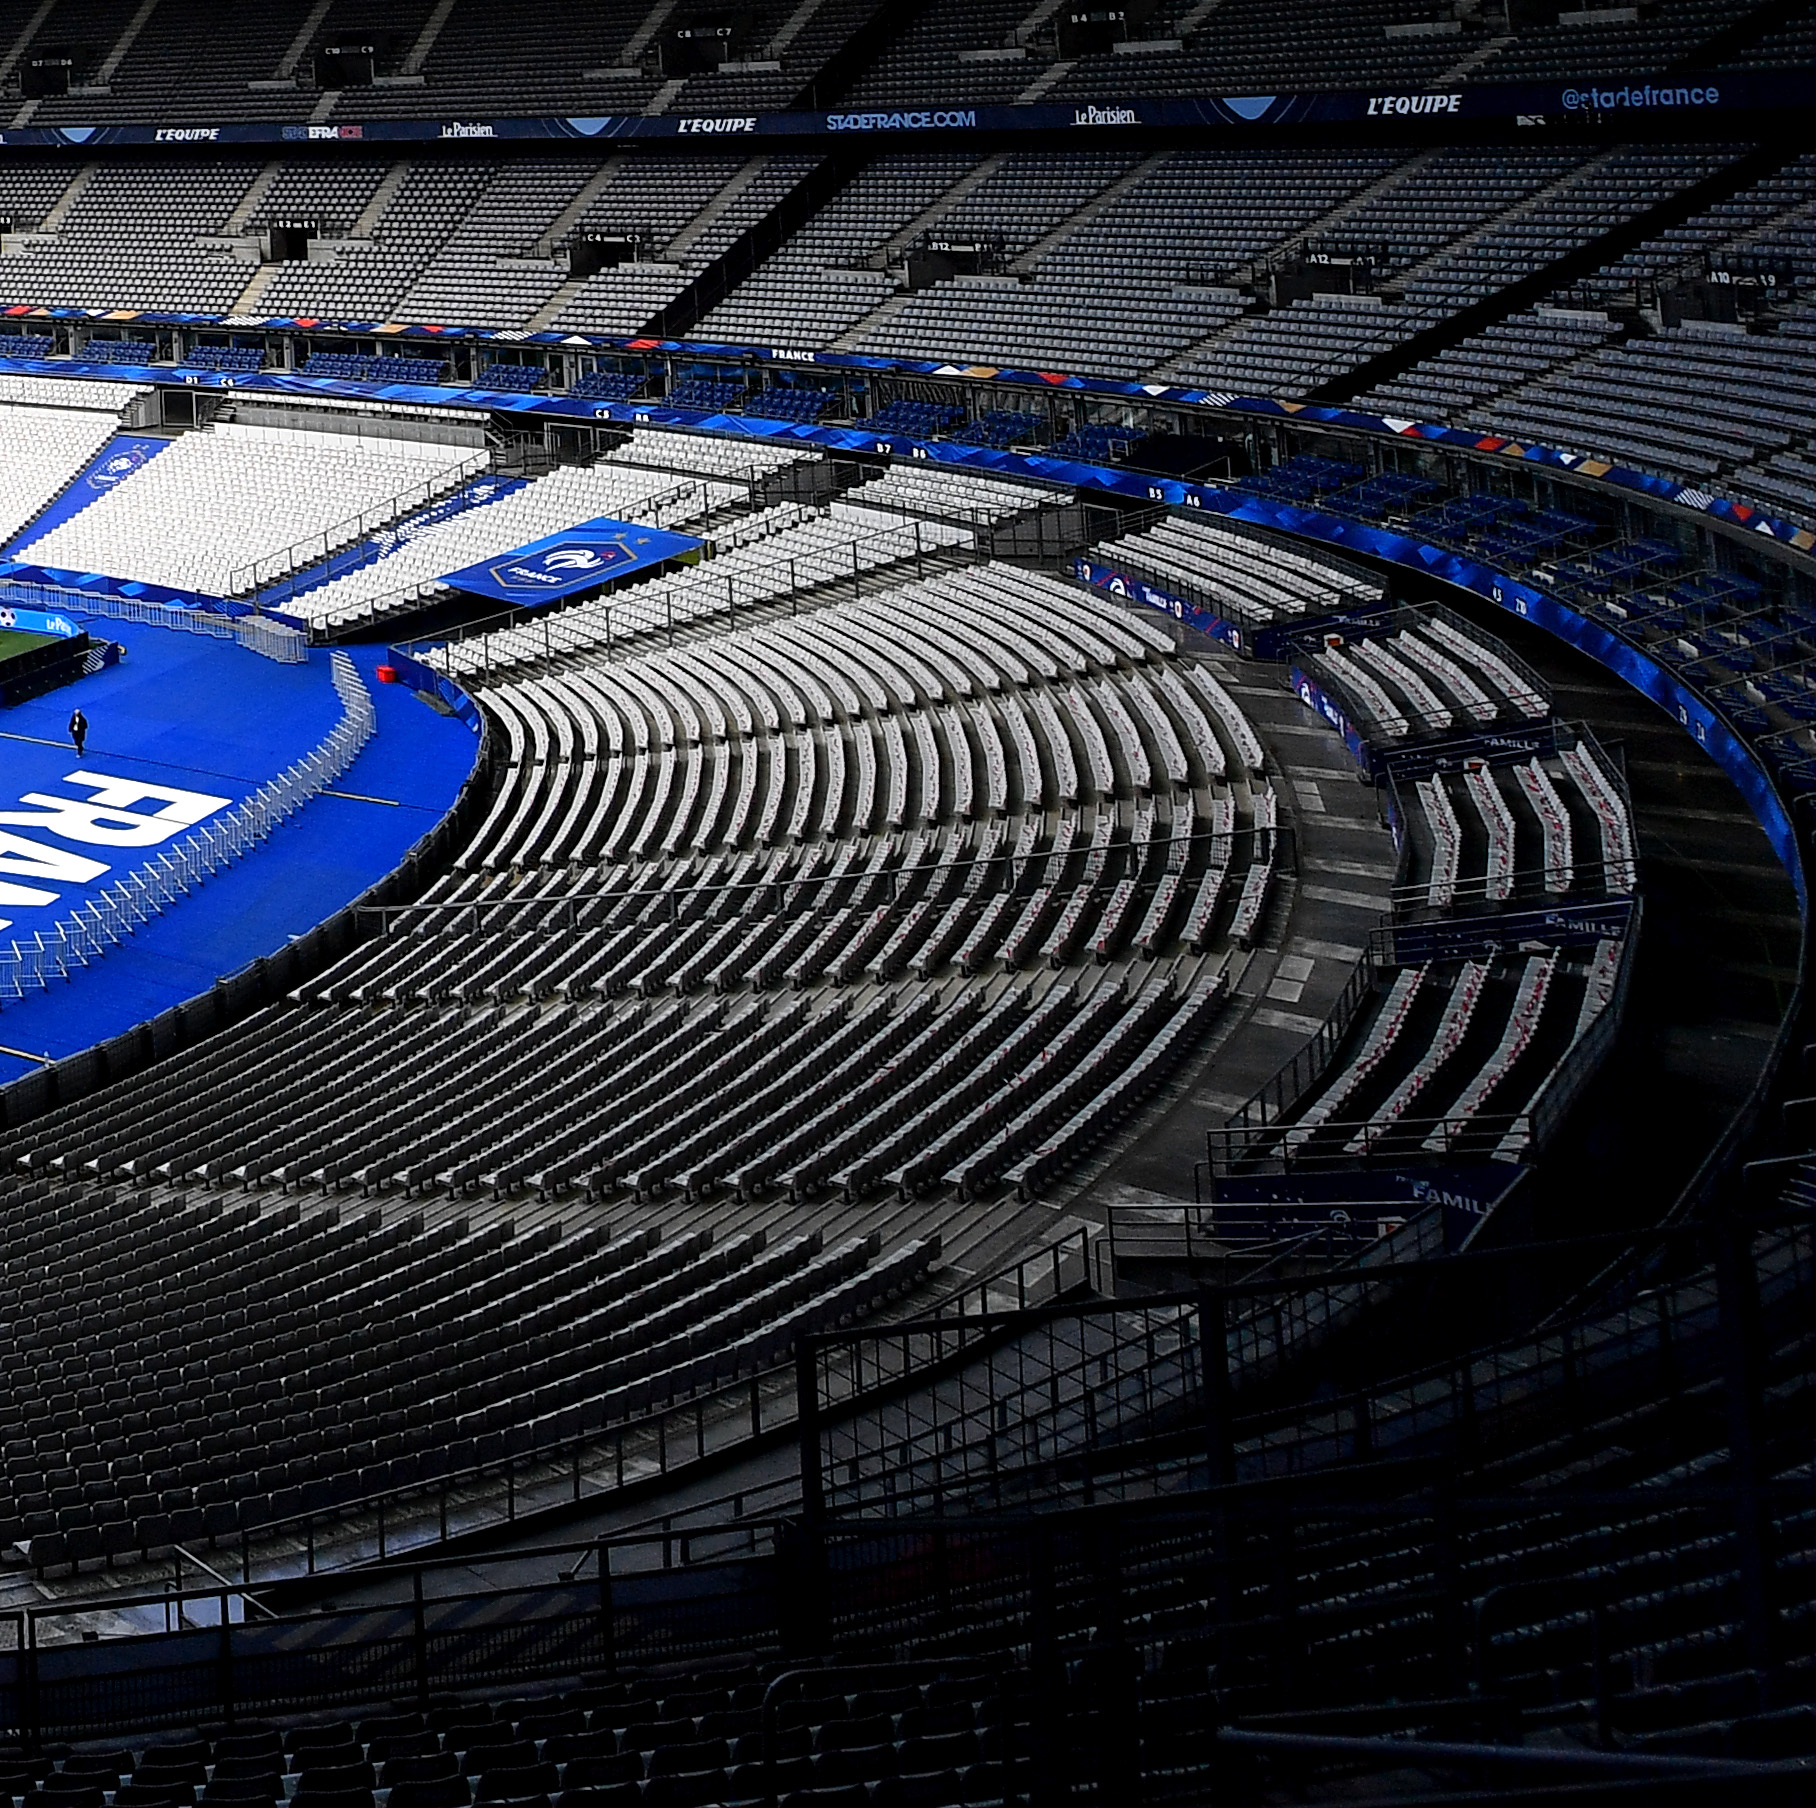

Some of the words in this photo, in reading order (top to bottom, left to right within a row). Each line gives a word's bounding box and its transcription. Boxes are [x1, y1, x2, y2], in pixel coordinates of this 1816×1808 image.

[1071, 13, 1088, 23] B4
[677, 29, 692, 39] C8
[716, 28, 731, 36] C7
[1561, 85, 1719, 110] @stadefrance
[1367, 94, 1463, 116] L'ÉQUIPE
[826, 110, 976, 131] STADEFRANCE.COM
[1075, 109, 1087, 123] Le
[1087, 105, 1135, 123] Parisien
[442, 126, 452, 137] Le
[453, 122, 493, 137] Parisien
[677, 117, 758, 133] L'ÉQUIPE
[154, 128, 220, 141] L'ÉQUIPE
[587, 233, 601, 242] C4
[1311, 254, 1330, 265] A12
[1710, 271, 1730, 284] A10
[772, 349, 816, 362] FRANCE
[186, 376, 199, 385] D1
[877, 442, 891, 454] B7
[912, 448, 927, 459] B6
[1149, 487, 1163, 500] B5
[1186, 495, 1201, 508] A6
[507, 565, 563, 585] FRANCE
[47, 619, 55, 629] Le
